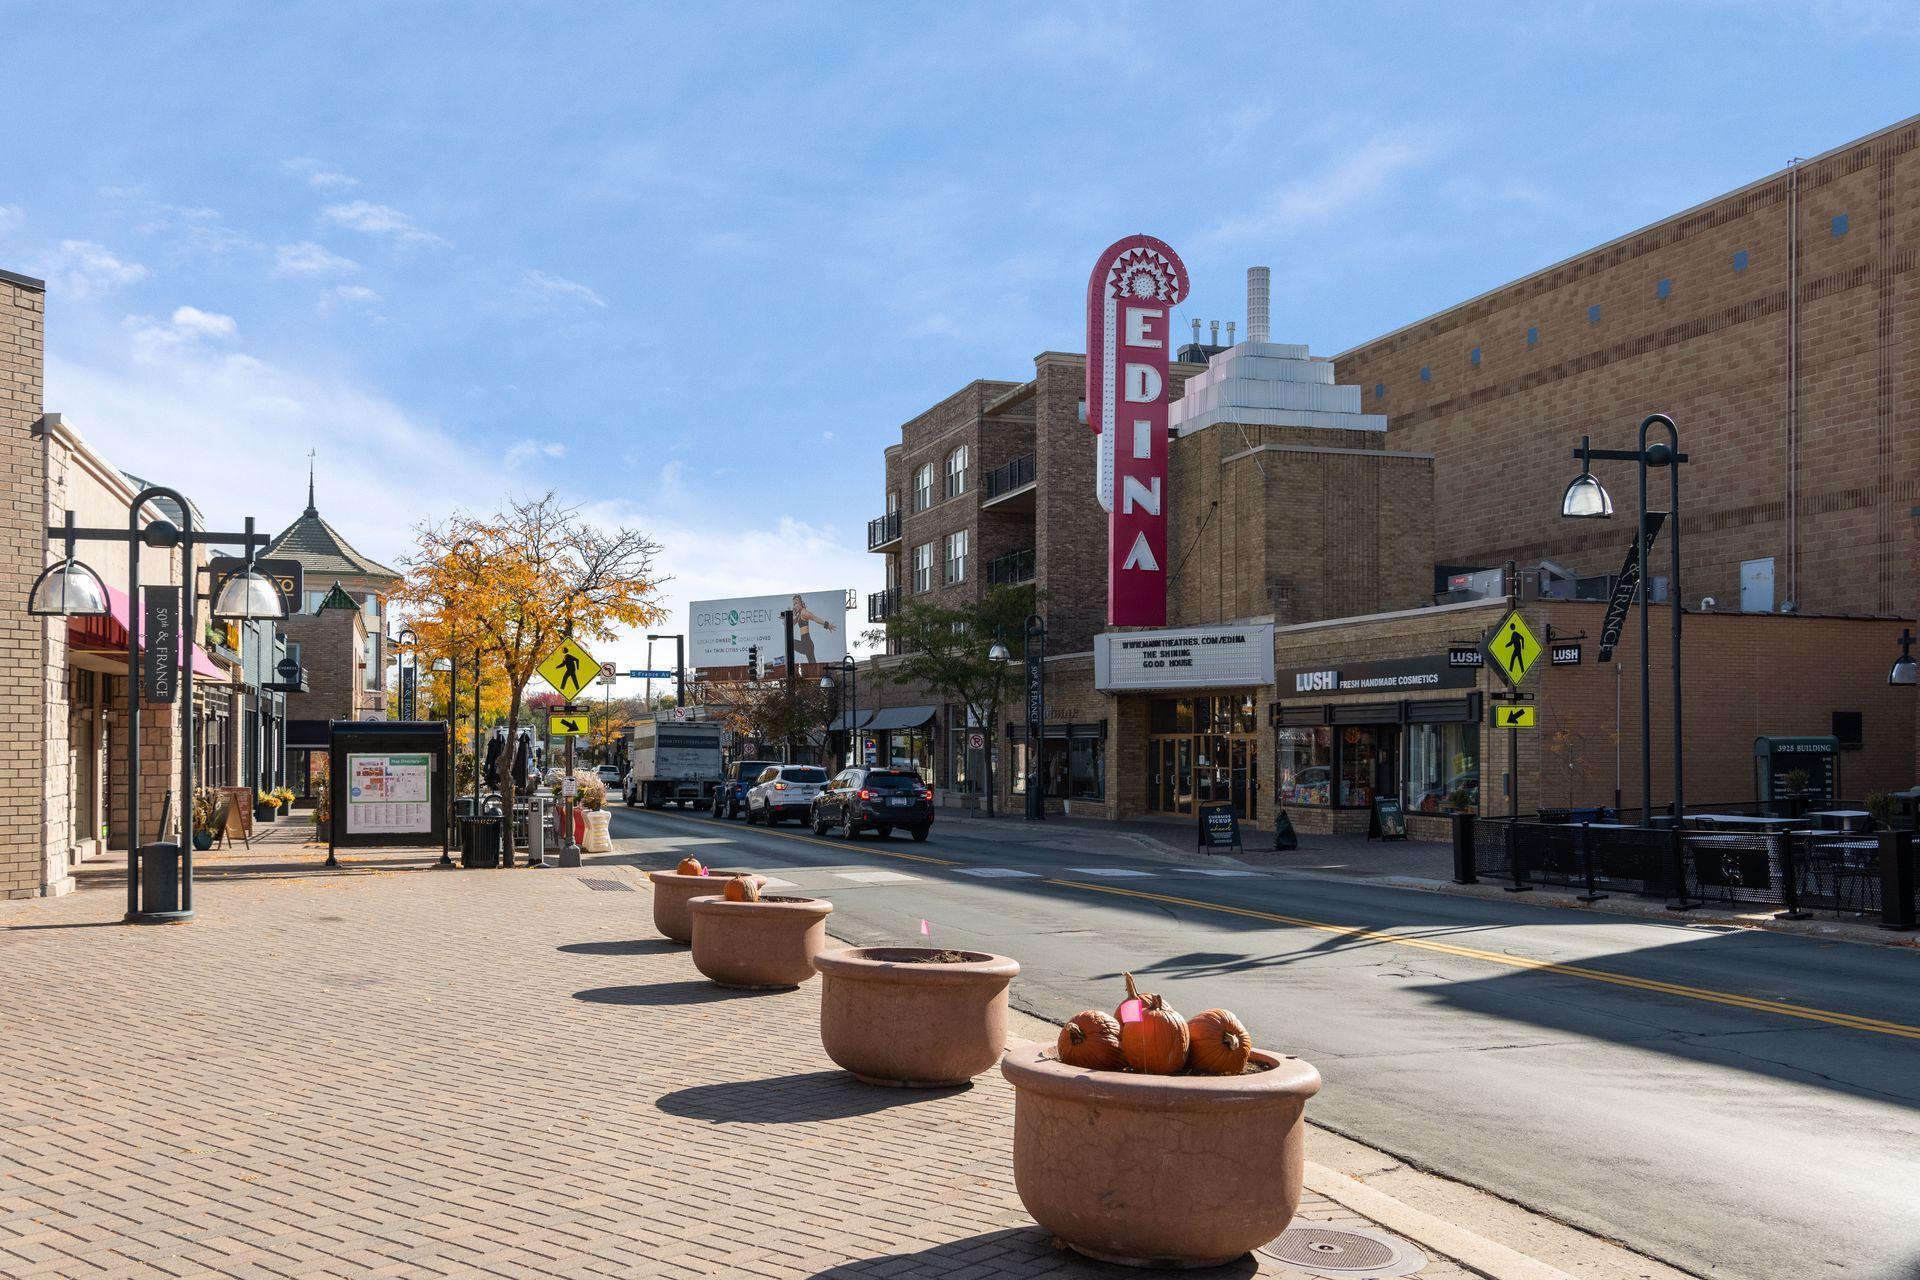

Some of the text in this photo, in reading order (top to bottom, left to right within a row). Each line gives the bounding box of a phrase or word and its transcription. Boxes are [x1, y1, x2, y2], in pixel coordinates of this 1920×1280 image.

[1123, 306, 1163, 571] EDINA
[715, 636, 731, 644] OWNED
[155, 607, 169, 697] 50th & FRANCE
[1142, 649, 1191, 658] THE SHINING
[1450, 652, 1482, 663] LUSH
[1553, 649, 1579, 661] LUSH
[1142, 659, 1192, 668] GOOD HOUSE
[637, 671, 659, 679] France
[1296, 671, 1439, 692] LUSH FRESH HANDMADE COSMETICS
[1030, 690, 1039, 724] FRANCE
[1777, 744, 1832, 752] 3925 BUILDING
